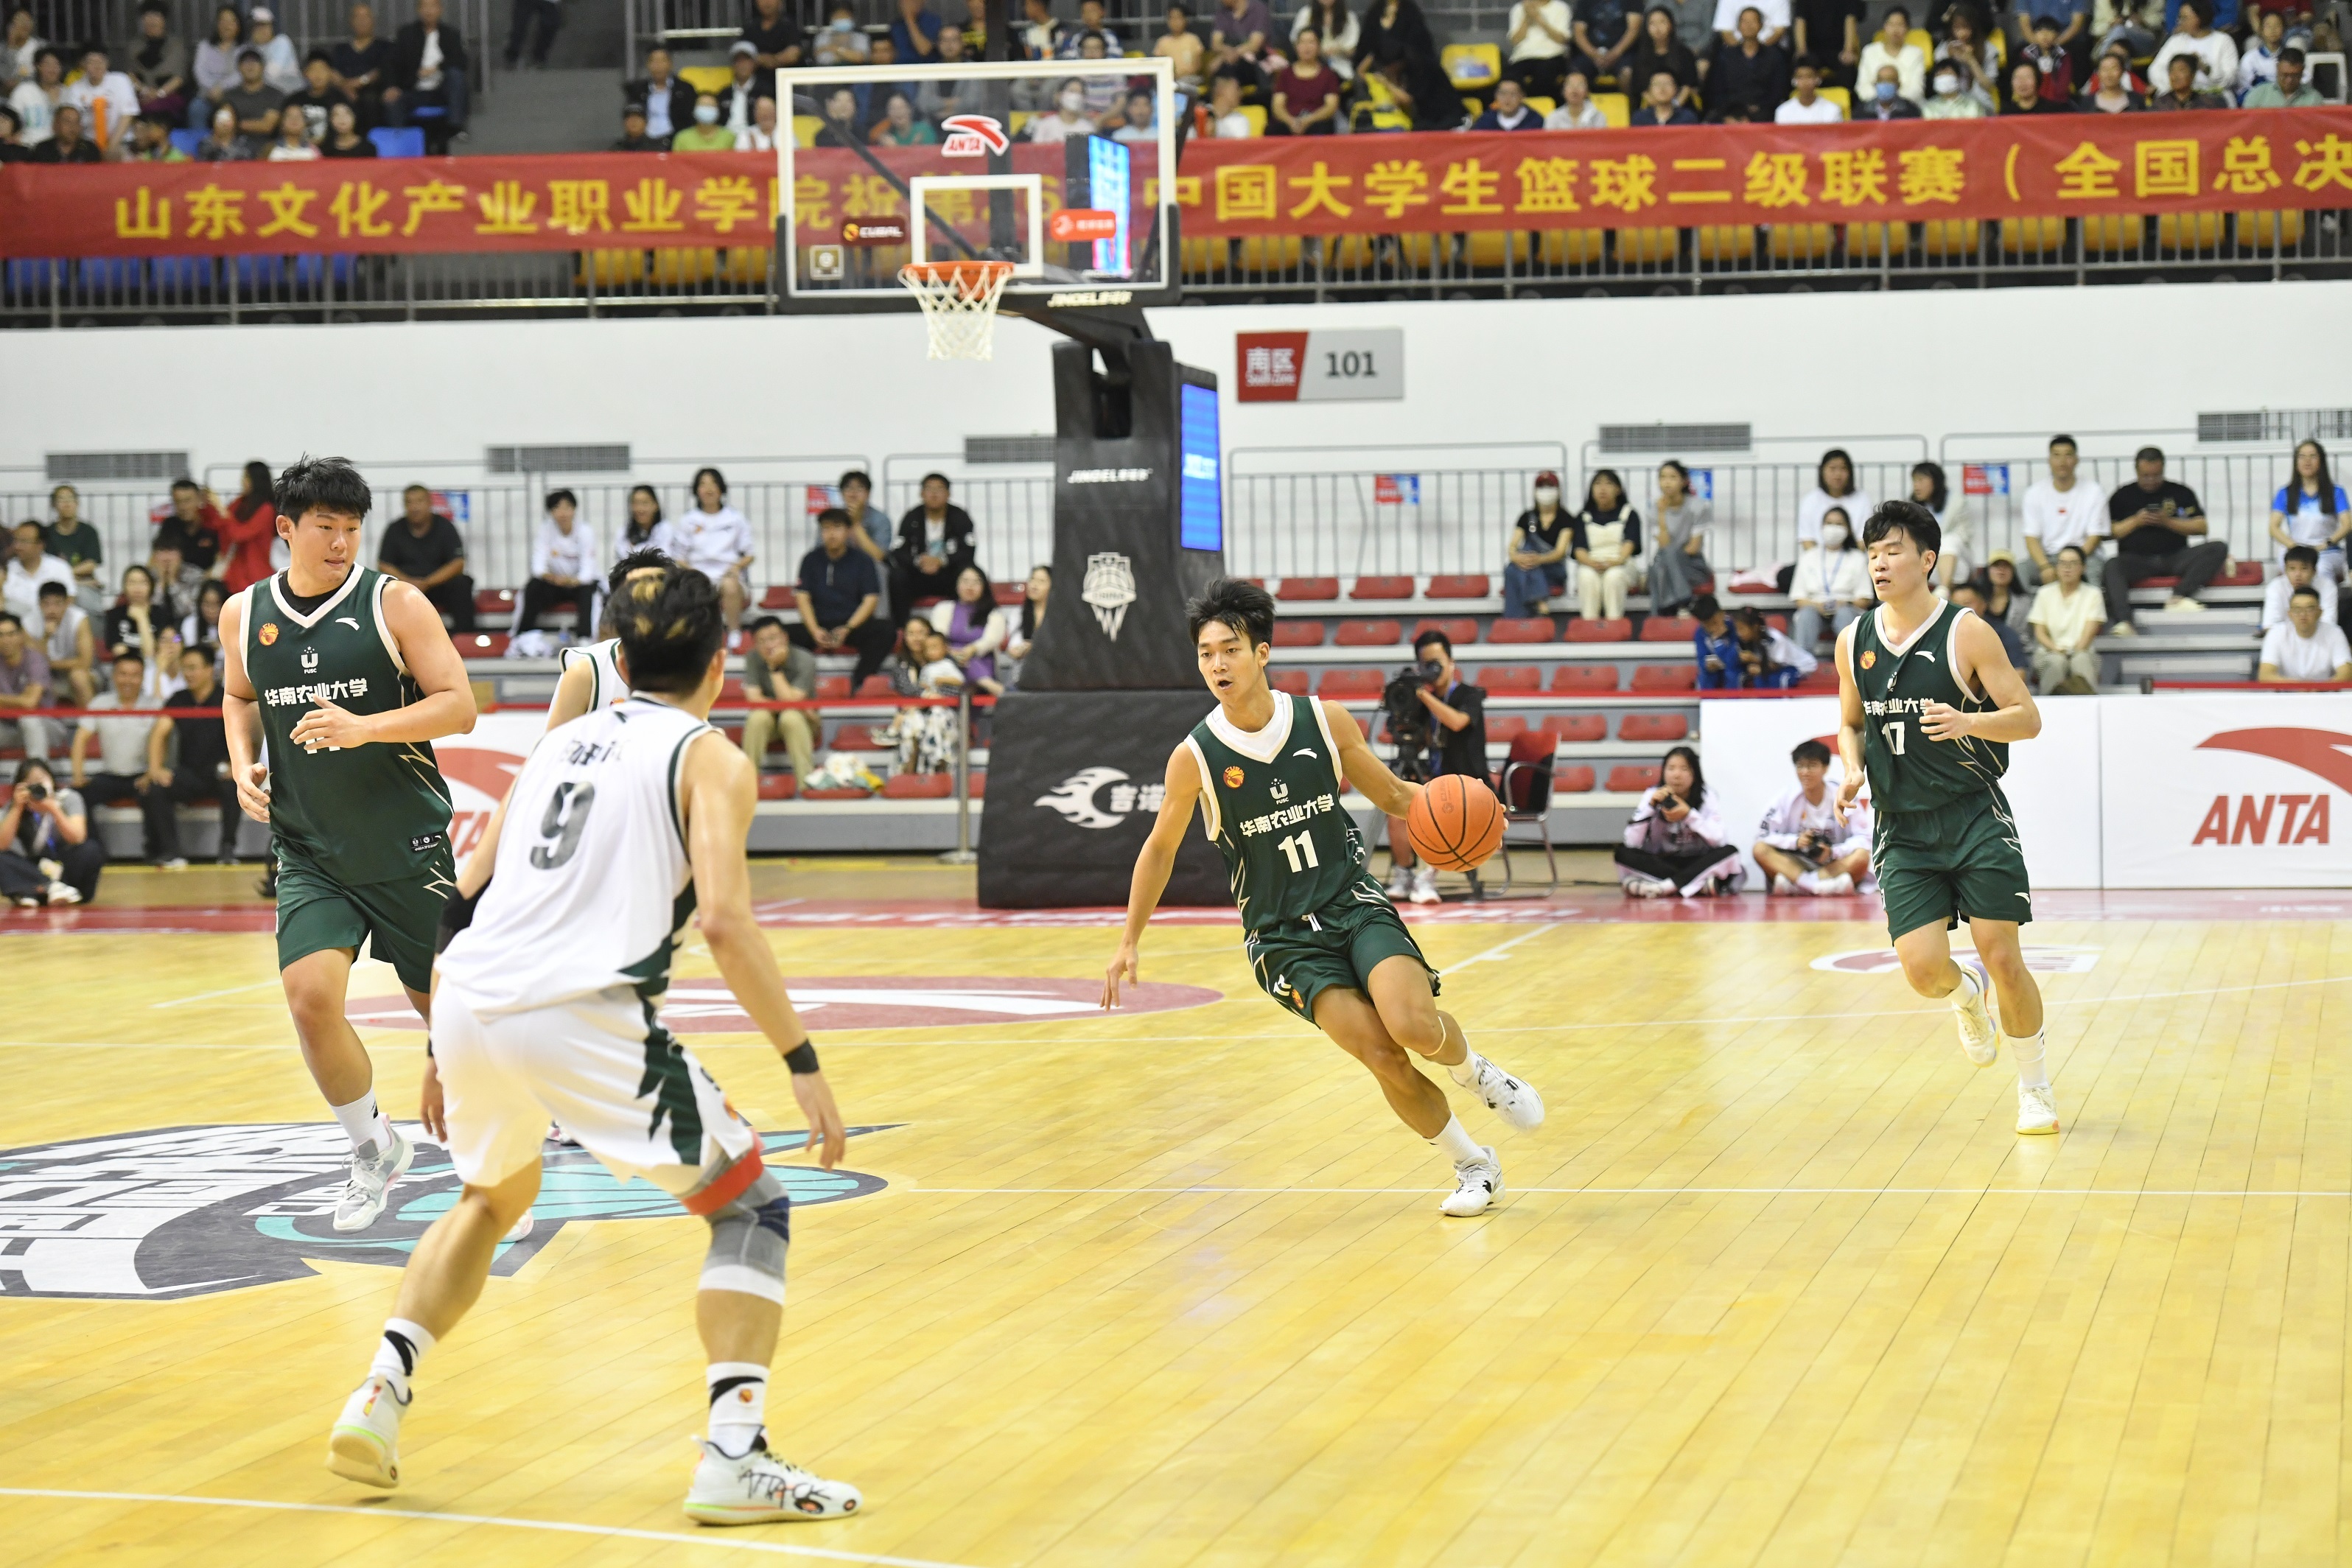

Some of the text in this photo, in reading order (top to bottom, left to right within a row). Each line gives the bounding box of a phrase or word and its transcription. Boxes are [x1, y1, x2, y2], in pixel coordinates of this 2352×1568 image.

[1245, 346, 1296, 374] 南区
[1326, 351, 1376, 377] 101
[265, 678, 368, 707] 华南农业大学
[1881, 721, 1905, 755] 17
[1239, 793, 1335, 838] 华南农业大学
[1275, 797, 1289, 805] FUSC
[529, 781, 595, 870] 9
[2191, 793, 2331, 847] ANTA
[1277, 829, 1319, 873] 11
